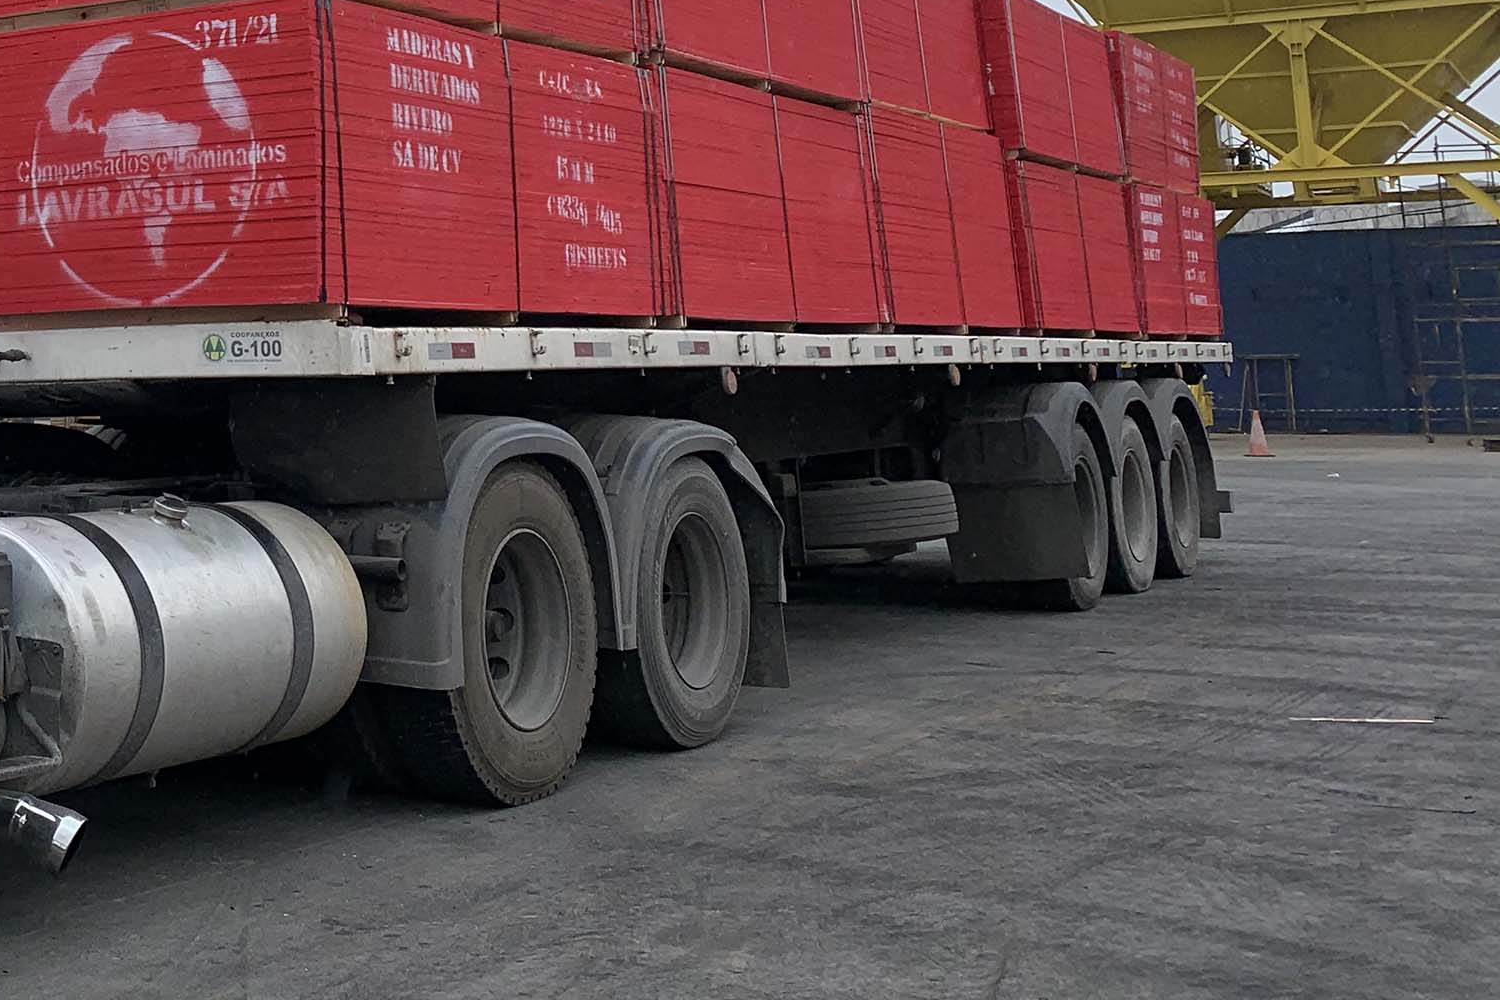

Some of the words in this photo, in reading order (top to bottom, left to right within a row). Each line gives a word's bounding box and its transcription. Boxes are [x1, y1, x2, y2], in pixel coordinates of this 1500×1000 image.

[195, 13, 279, 50] 371/21
[387, 26, 462, 65] MADERAS
[389, 63, 480, 105] DERIVADOS
[391, 102, 453, 136] RIVERO
[17, 152, 150, 184] Compensados
[174, 143, 287, 170] Laminados
[393, 140, 414, 168] SA
[418, 143, 439, 172] DE
[442, 148, 462, 174] CV
[18, 176, 216, 225] LAVRASUL
[230, 340, 283, 358] G-100
